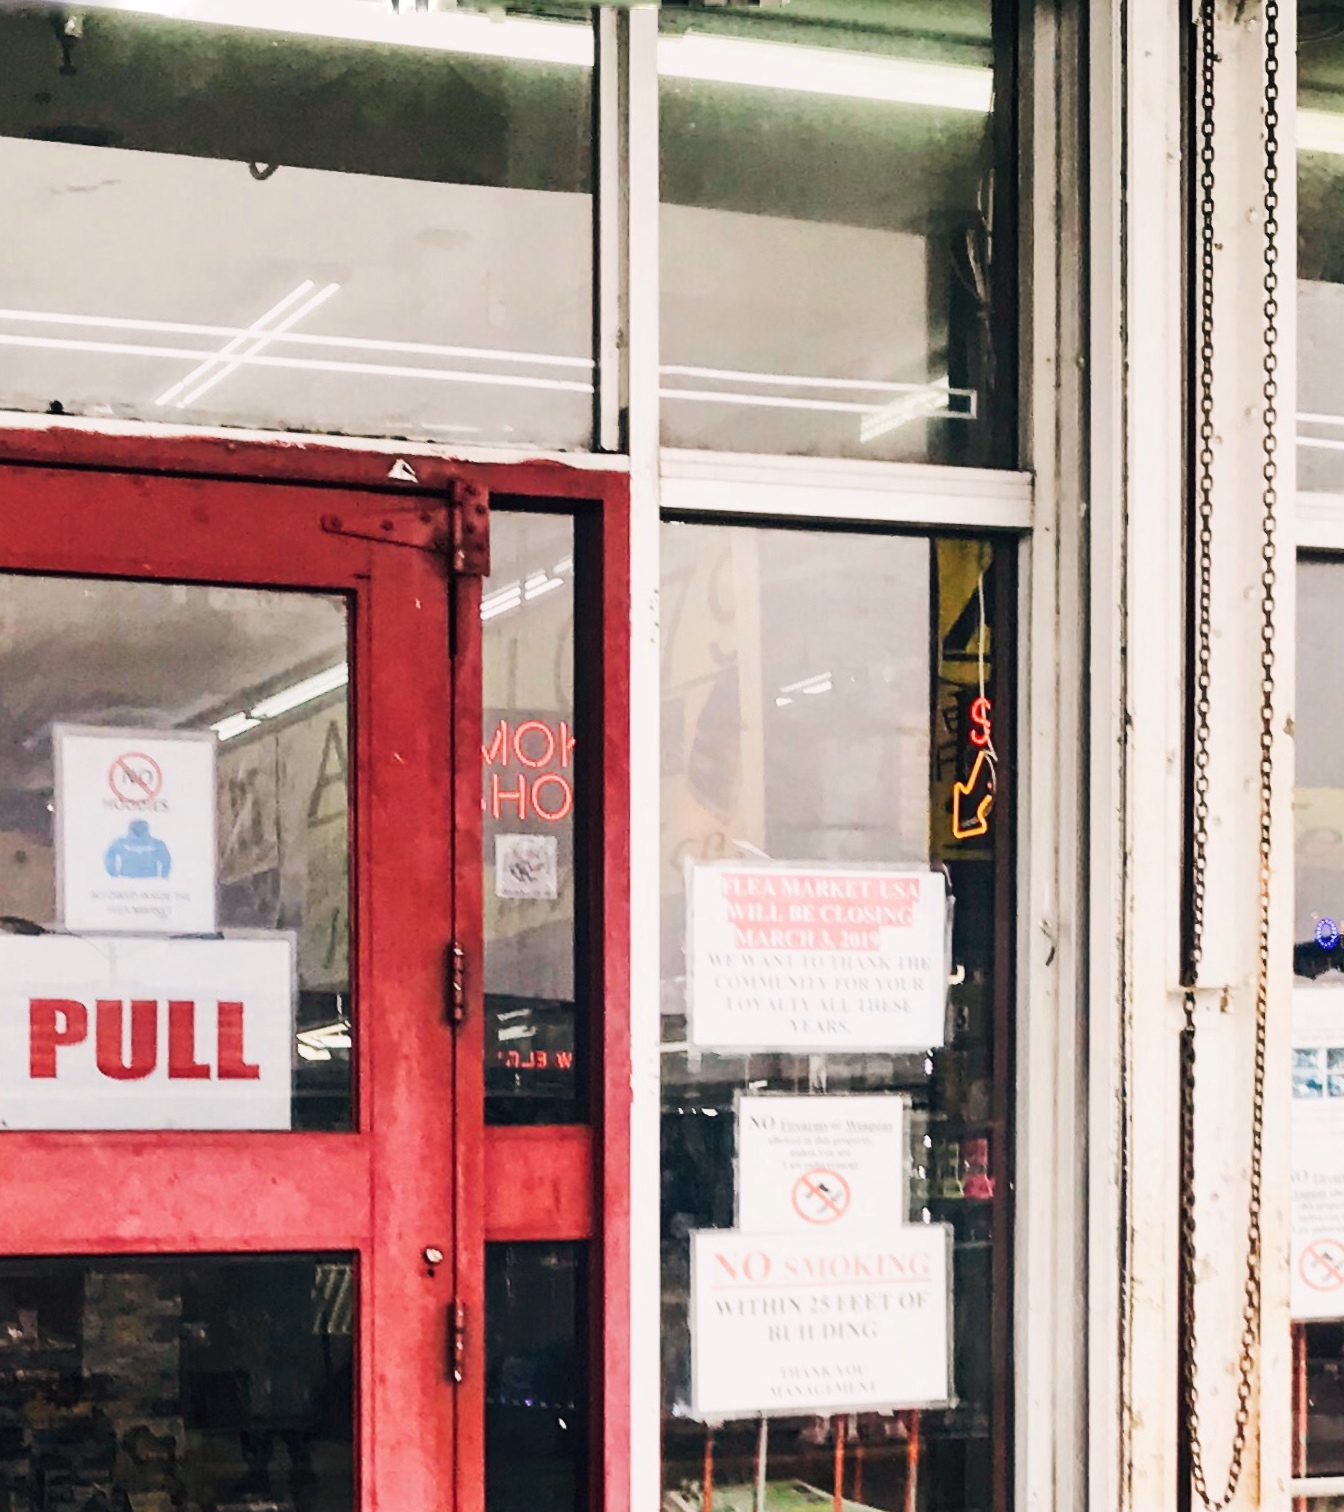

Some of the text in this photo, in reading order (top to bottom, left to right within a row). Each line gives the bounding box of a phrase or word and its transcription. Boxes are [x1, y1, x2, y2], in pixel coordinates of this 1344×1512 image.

[722, 878, 920, 900] FLEA MARKET USA
[727, 902, 913, 925] WILL BE CLOSING
[736, 927, 815, 947] MARCH
[840, 930, 880, 949] 2019
[742, 953, 794, 969] WANT
[829, 955, 891, 971] THANK
[898, 956, 933, 972] THE
[714, 975, 926, 993] COMMUNITY FOR YOUR
[29, 999, 260, 1081] PULL
[713, 1250, 930, 1281] NO SMOKING
[714, 1291, 930, 1316] WITHIN 25 FEET OF
[768, 1321, 877, 1342] BUILDING
[769, 1380, 878, 1398] MANAGEMENT
